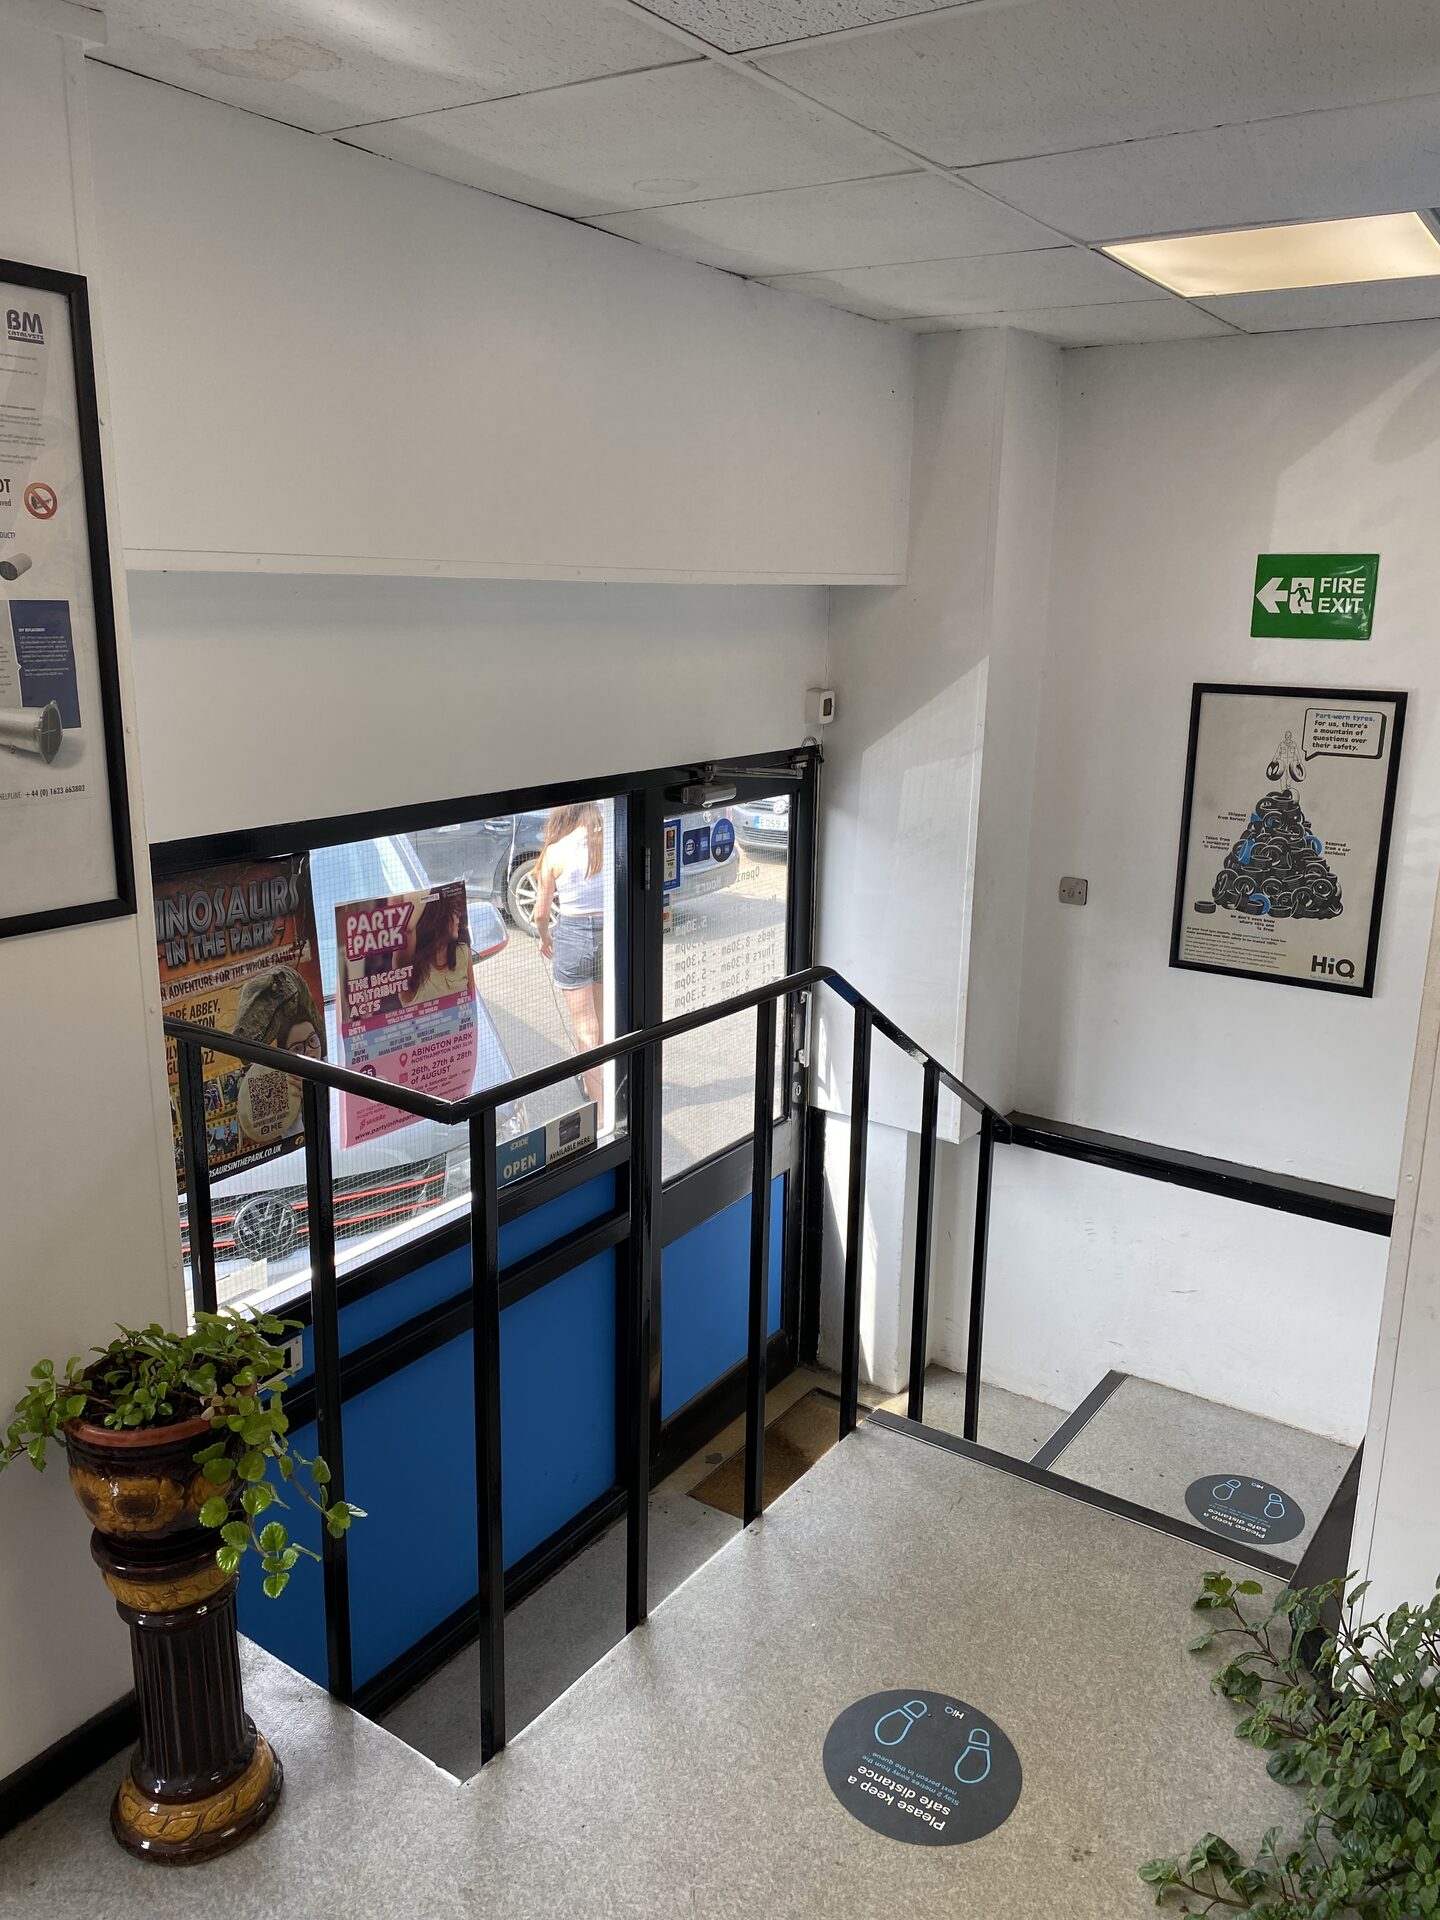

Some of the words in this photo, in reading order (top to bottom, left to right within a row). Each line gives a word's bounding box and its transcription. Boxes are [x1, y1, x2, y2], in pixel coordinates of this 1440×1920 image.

[7, 309, 44, 335] BM
[8, 330, 44, 340] CATALYSTS
[1320, 577, 1366, 594] FIRE
[1317, 597, 1364, 614] EXIT
[1315, 712, 1350, 721] Part-worn
[1353, 714, 1376, 722] tyres.
[1320, 728, 1353, 736] mountain
[1333, 743, 1358, 752] safety.
[40, 788, 49, 798] (0)
[346, 904, 409, 938] PARTY
[165, 938, 188, 967] IN
[190, 930, 227, 962] THE
[230, 920, 275, 952] PARK
[353, 926, 403, 956] PARK
[1311, 954, 1355, 979] HiQ
[169, 972, 214, 999] ADVENTURE
[215, 969, 231, 985] FOR
[232, 964, 247, 979] THE
[246, 955, 271, 974] WHOLE
[348, 975, 369, 993] THE
[370, 965, 414, 988] BIGGEST
[366, 978, 409, 1003] TRIBUTE
[189, 998, 221, 1020] ABBEY,
[349, 1000, 381, 1018] ACTS
[411, 1039, 452, 1058] ABINGTON
[453, 1031, 473, 1045] PARK
[411, 1047, 451, 1064] NORTHAMPTON
[411, 1064, 431, 1077] 26th,
[432, 1058, 448, 1070] 27th
[449, 1055, 455, 1064] &
[456, 1050, 473, 1062] 28th
[410, 1075, 419, 1085] of
[420, 1065, 452, 1082] AUGUST
[270, 1121, 283, 1132] ME
[549, 1142, 577, 1161] AVAILABLE
[576, 1135, 591, 1148] HERE
[503, 1152, 537, 1179] OPEN
[1207, 1508, 1245, 1525] distance
[1211, 1514, 1233, 1527] keep
[1234, 1522, 1266, 1539] Please
[1247, 1522, 1267, 1533] safe
[944, 1705, 965, 1721] HiQ
[862, 1754, 874, 1764] the
[872, 1751, 894, 1765] queue
[874, 1761, 892, 1773] from
[891, 1769, 911, 1782] away
[894, 1763, 906, 1772] the
[907, 1768, 915, 1776] in
[847, 1774, 858, 1785] a
[857, 1765, 917, 1799] distance
[911, 1779, 937, 1794] metres
[915, 1772, 942, 1788] person
[860, 1781, 895, 1806] keep
[941, 1784, 958, 1797] next
[919, 1795, 951, 1816] safe
[944, 1794, 960, 1806] Stay
[897, 1799, 946, 1832] Please
